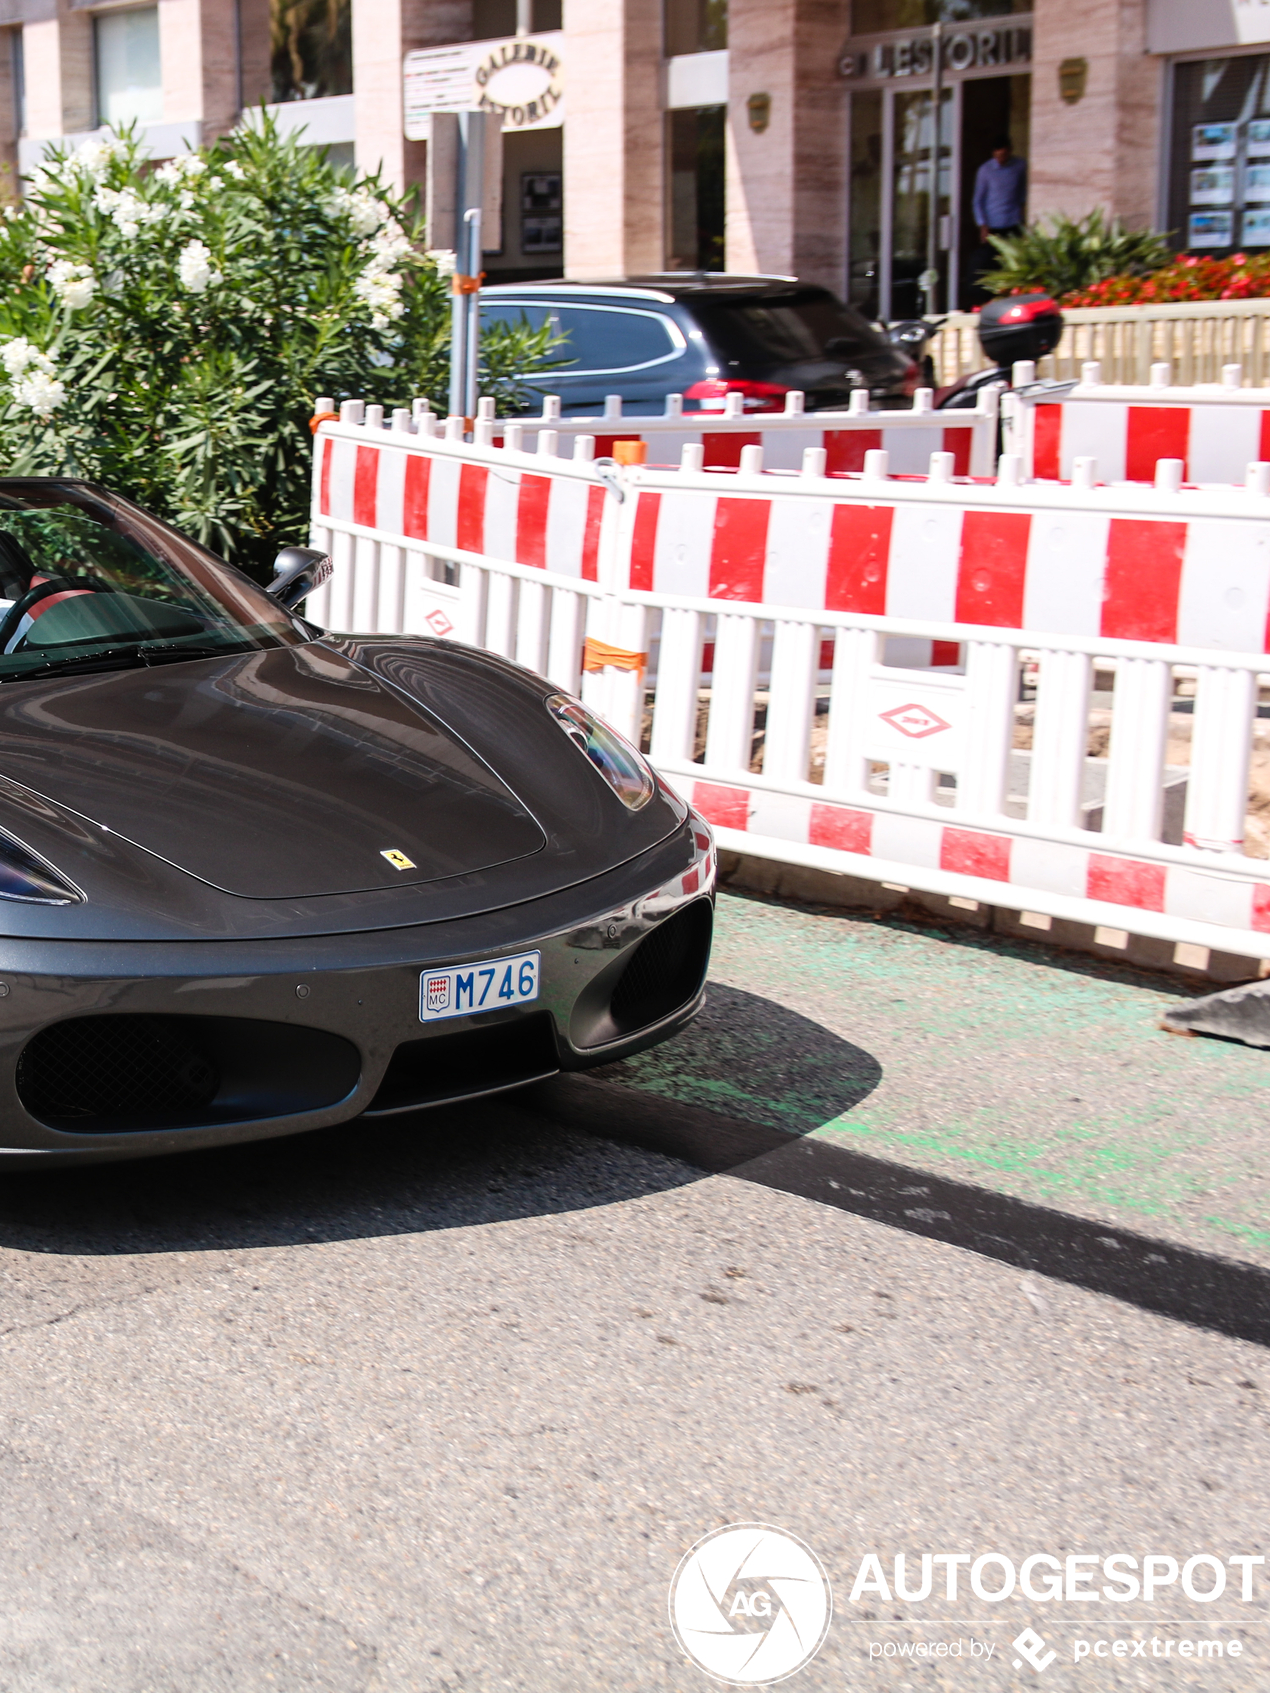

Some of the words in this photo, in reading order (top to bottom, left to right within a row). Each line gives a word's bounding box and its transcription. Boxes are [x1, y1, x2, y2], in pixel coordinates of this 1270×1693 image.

[475, 43, 561, 87] GALERIE
[429, 993, 446, 1006] MC
[456, 960, 534, 1010] M746
